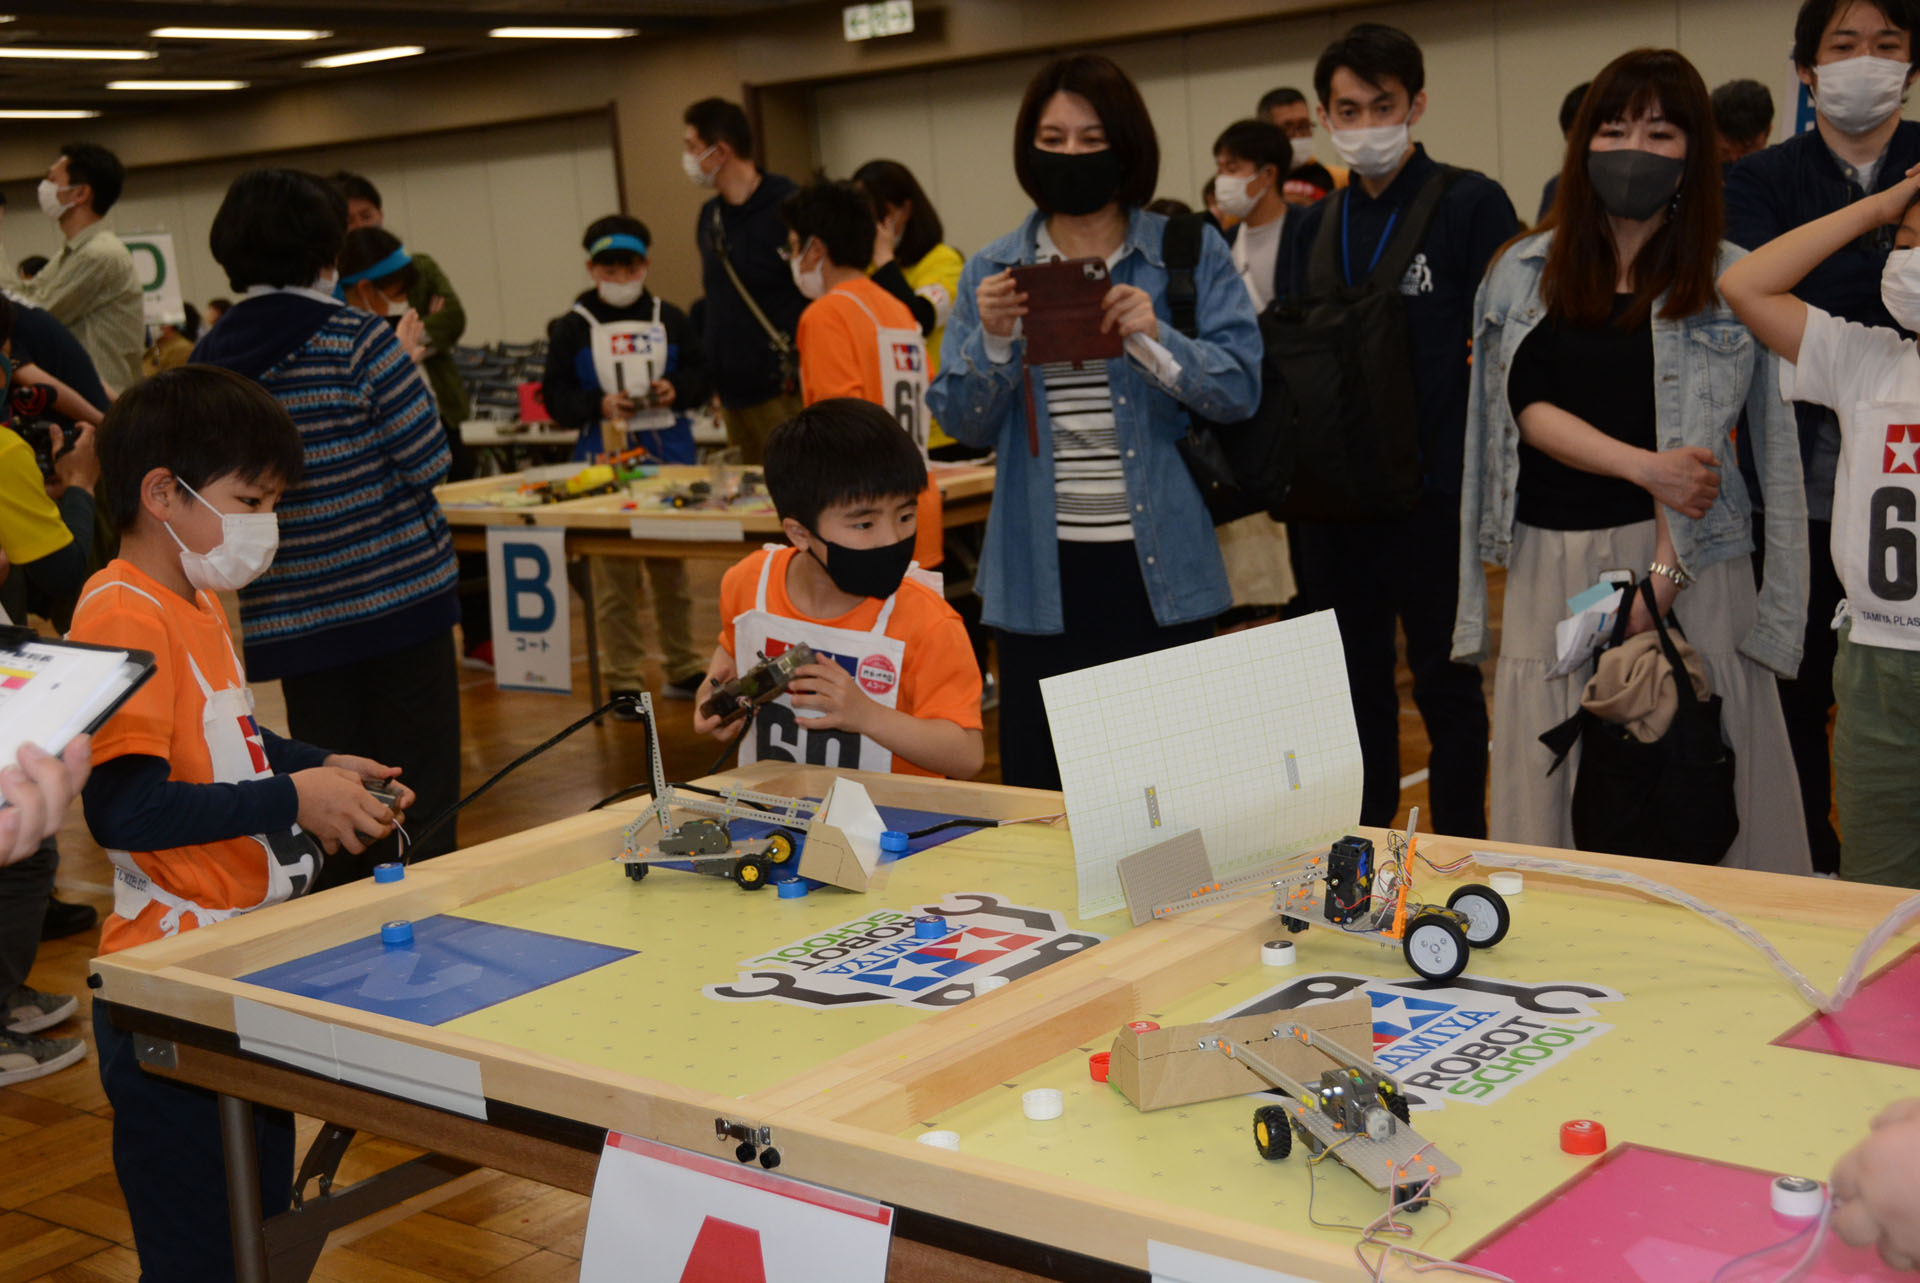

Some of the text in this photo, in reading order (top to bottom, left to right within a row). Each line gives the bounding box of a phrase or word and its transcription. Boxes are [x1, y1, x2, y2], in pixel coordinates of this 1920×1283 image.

[1868, 486, 1918, 602] 6
[503, 542, 556, 632] B
[516, 637, 550, 652] コート
[753, 912, 903, 963] SCHOOL
[790, 916, 917, 971] ROBOT
[816, 924, 968, 975] TMIYA
[1373, 1010, 1501, 1075] AMIYA
[1403, 1015, 1547, 1091] ROBOT
[1447, 1025, 1595, 1099] SCHOOL
